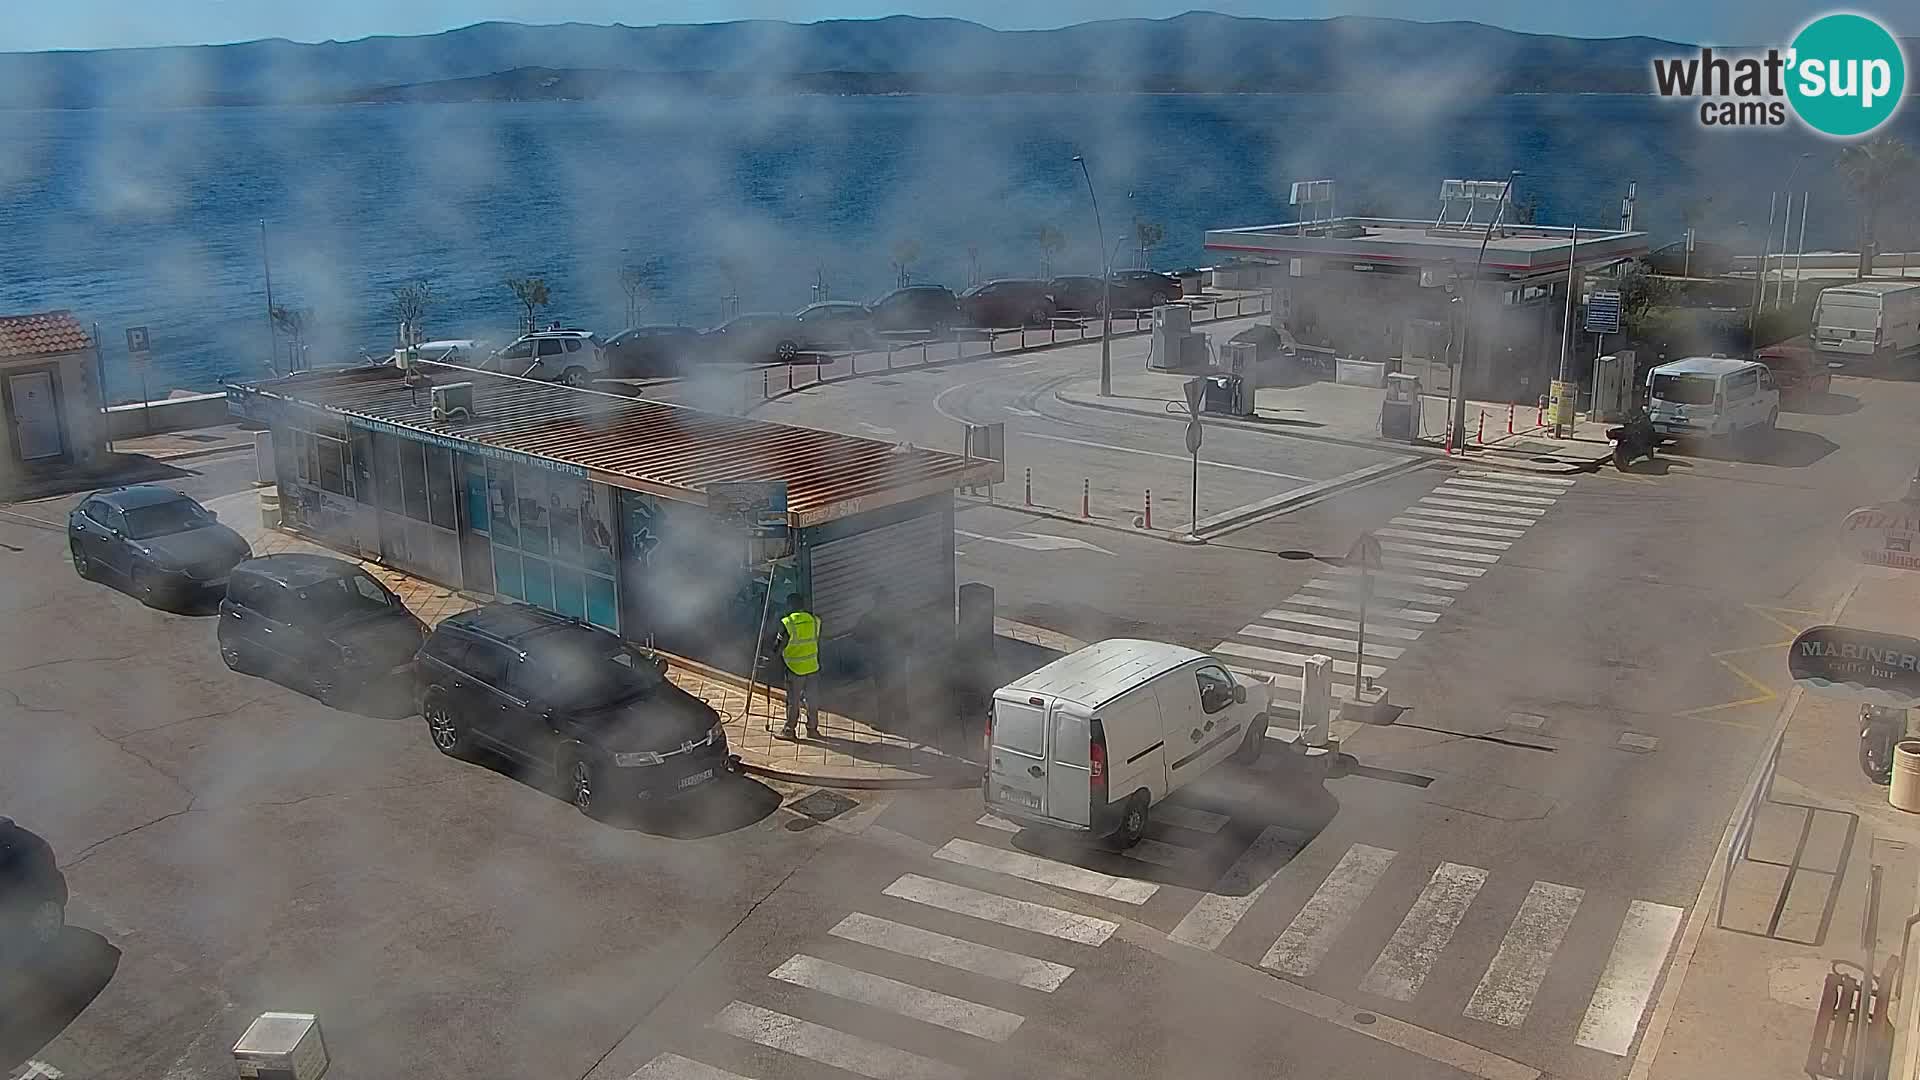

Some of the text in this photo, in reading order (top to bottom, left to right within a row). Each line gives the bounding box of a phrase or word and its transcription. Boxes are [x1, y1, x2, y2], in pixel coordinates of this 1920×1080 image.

[495, 449, 527, 465] STATION
[529, 456, 555, 470] TICKET
[556, 462, 583, 476] OFFICE
[1871, 665, 1897, 679] bar
